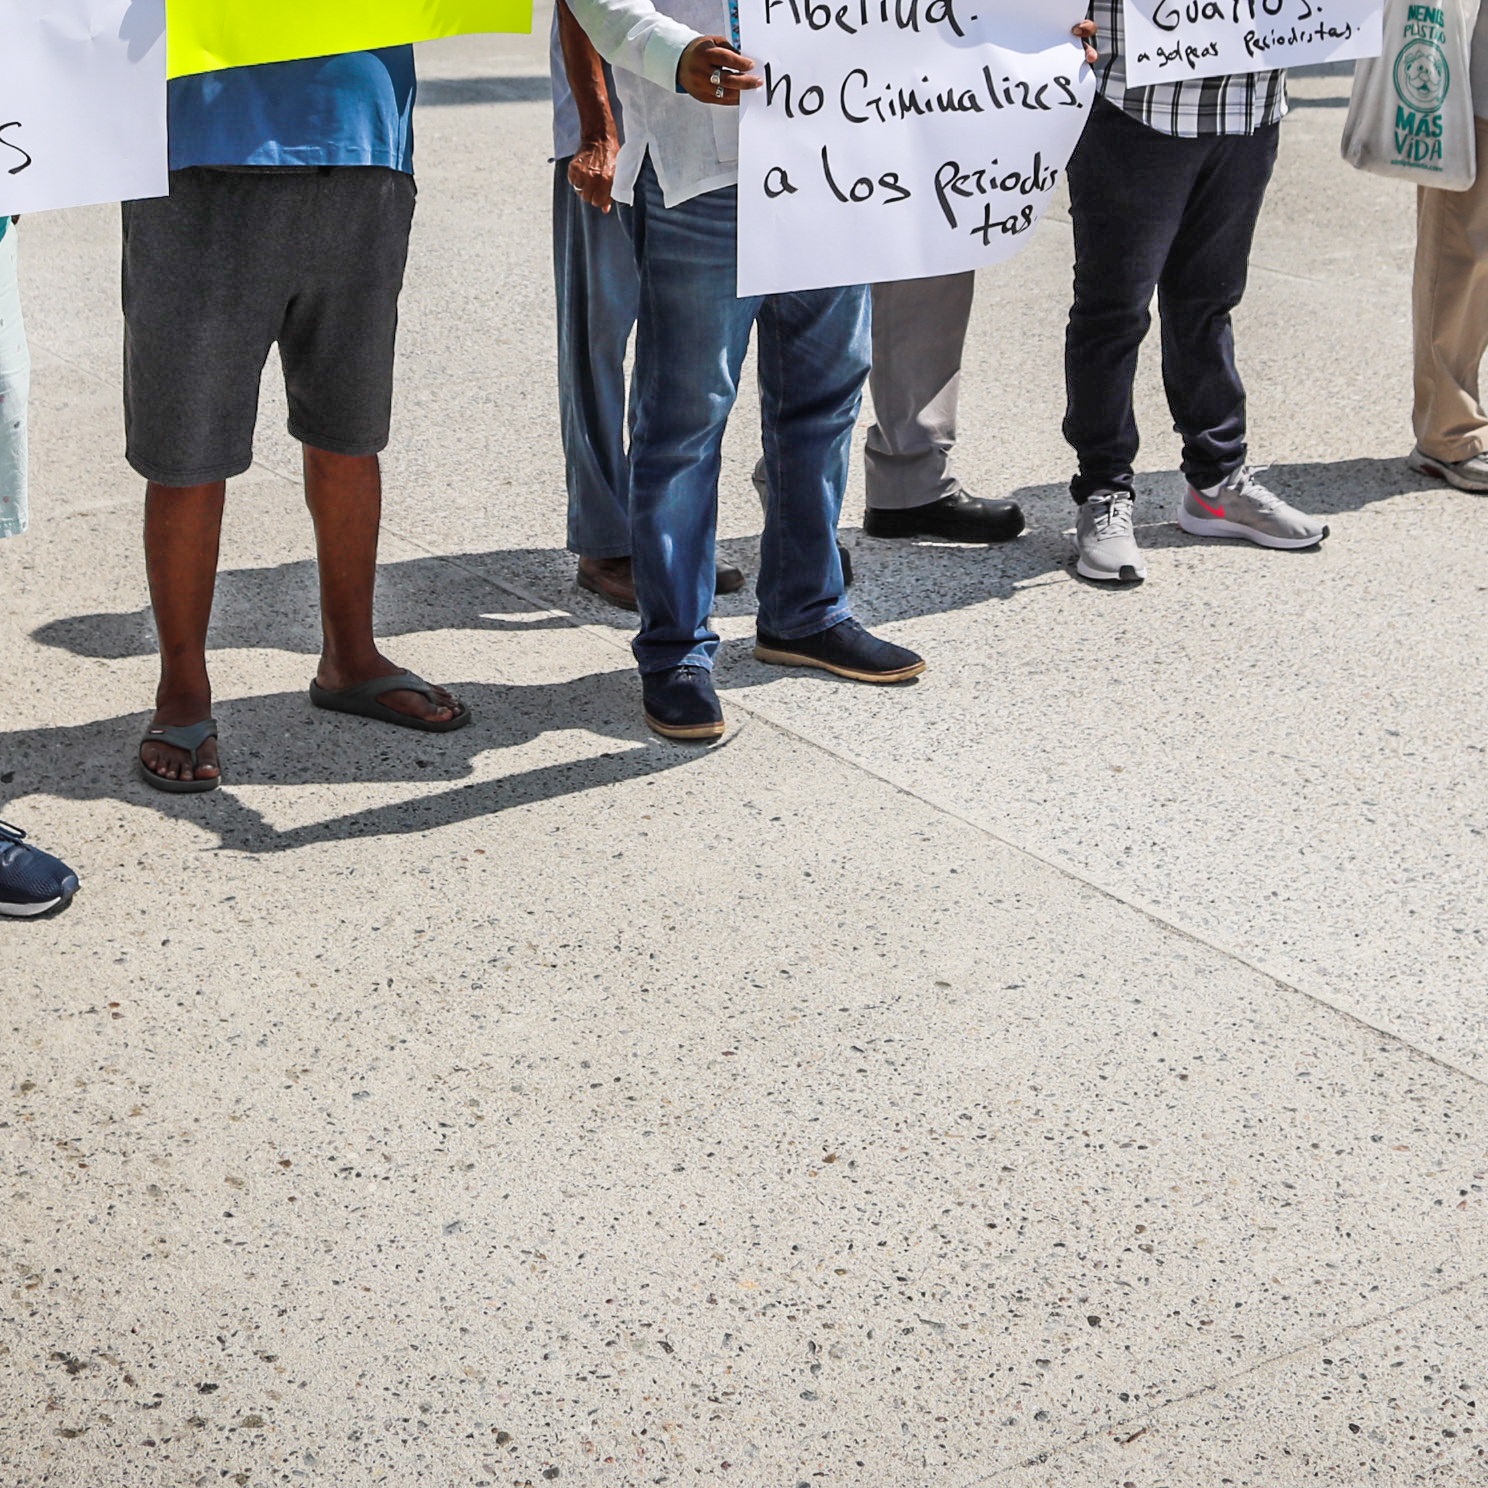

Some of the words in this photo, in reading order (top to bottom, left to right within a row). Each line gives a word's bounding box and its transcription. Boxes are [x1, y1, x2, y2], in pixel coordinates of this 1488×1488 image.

[1137, 51, 1151, 63] a
[1395, 104, 1443, 138] MÁS
[763, 165, 799, 200] a
[821, 144, 912, 206] los
